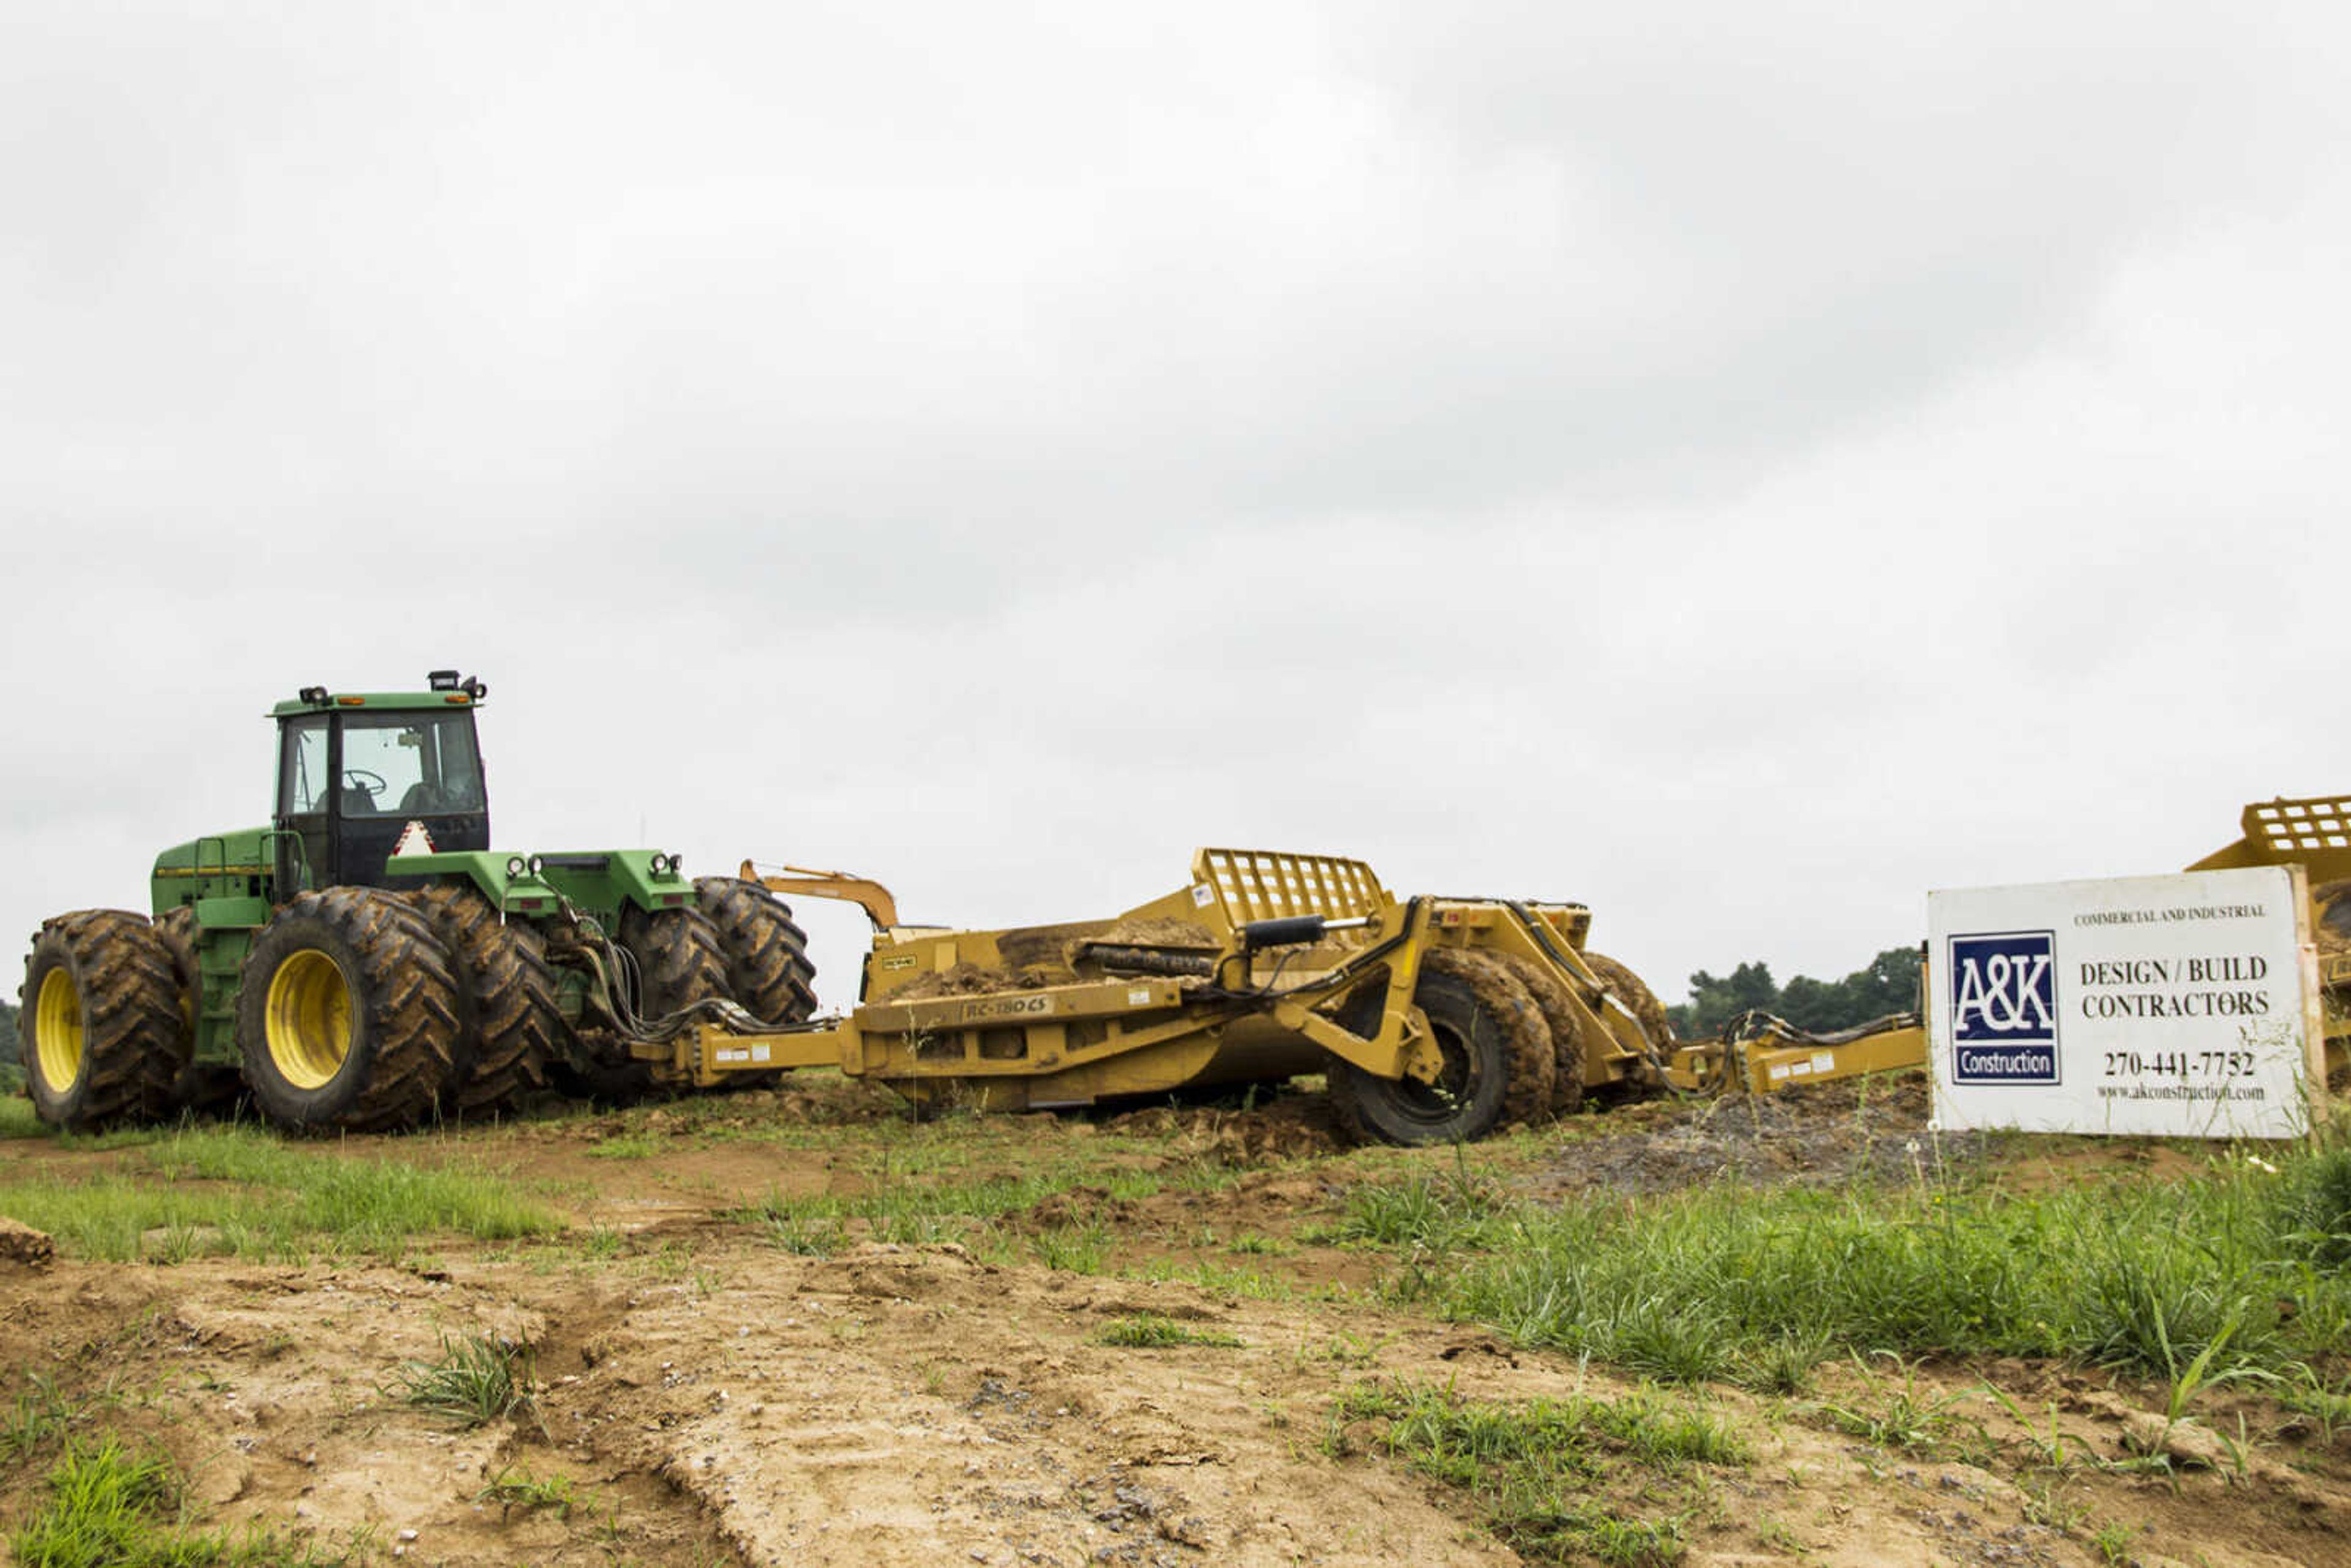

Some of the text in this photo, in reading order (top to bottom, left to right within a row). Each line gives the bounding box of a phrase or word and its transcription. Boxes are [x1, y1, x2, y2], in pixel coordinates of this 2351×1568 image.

[2074, 904, 2267, 926] COMMERCIAL AND INDUSTRIAL
[2080, 959, 2169, 986] DESIGN
[2189, 956, 2267, 982] BUILD
[1954, 953, 2055, 1031] A&K
[2082, 990, 2270, 1019] CONTRACTORS
[1961, 1049, 2050, 1073] Construction
[2104, 1052, 2255, 1076] 270-441-7752
